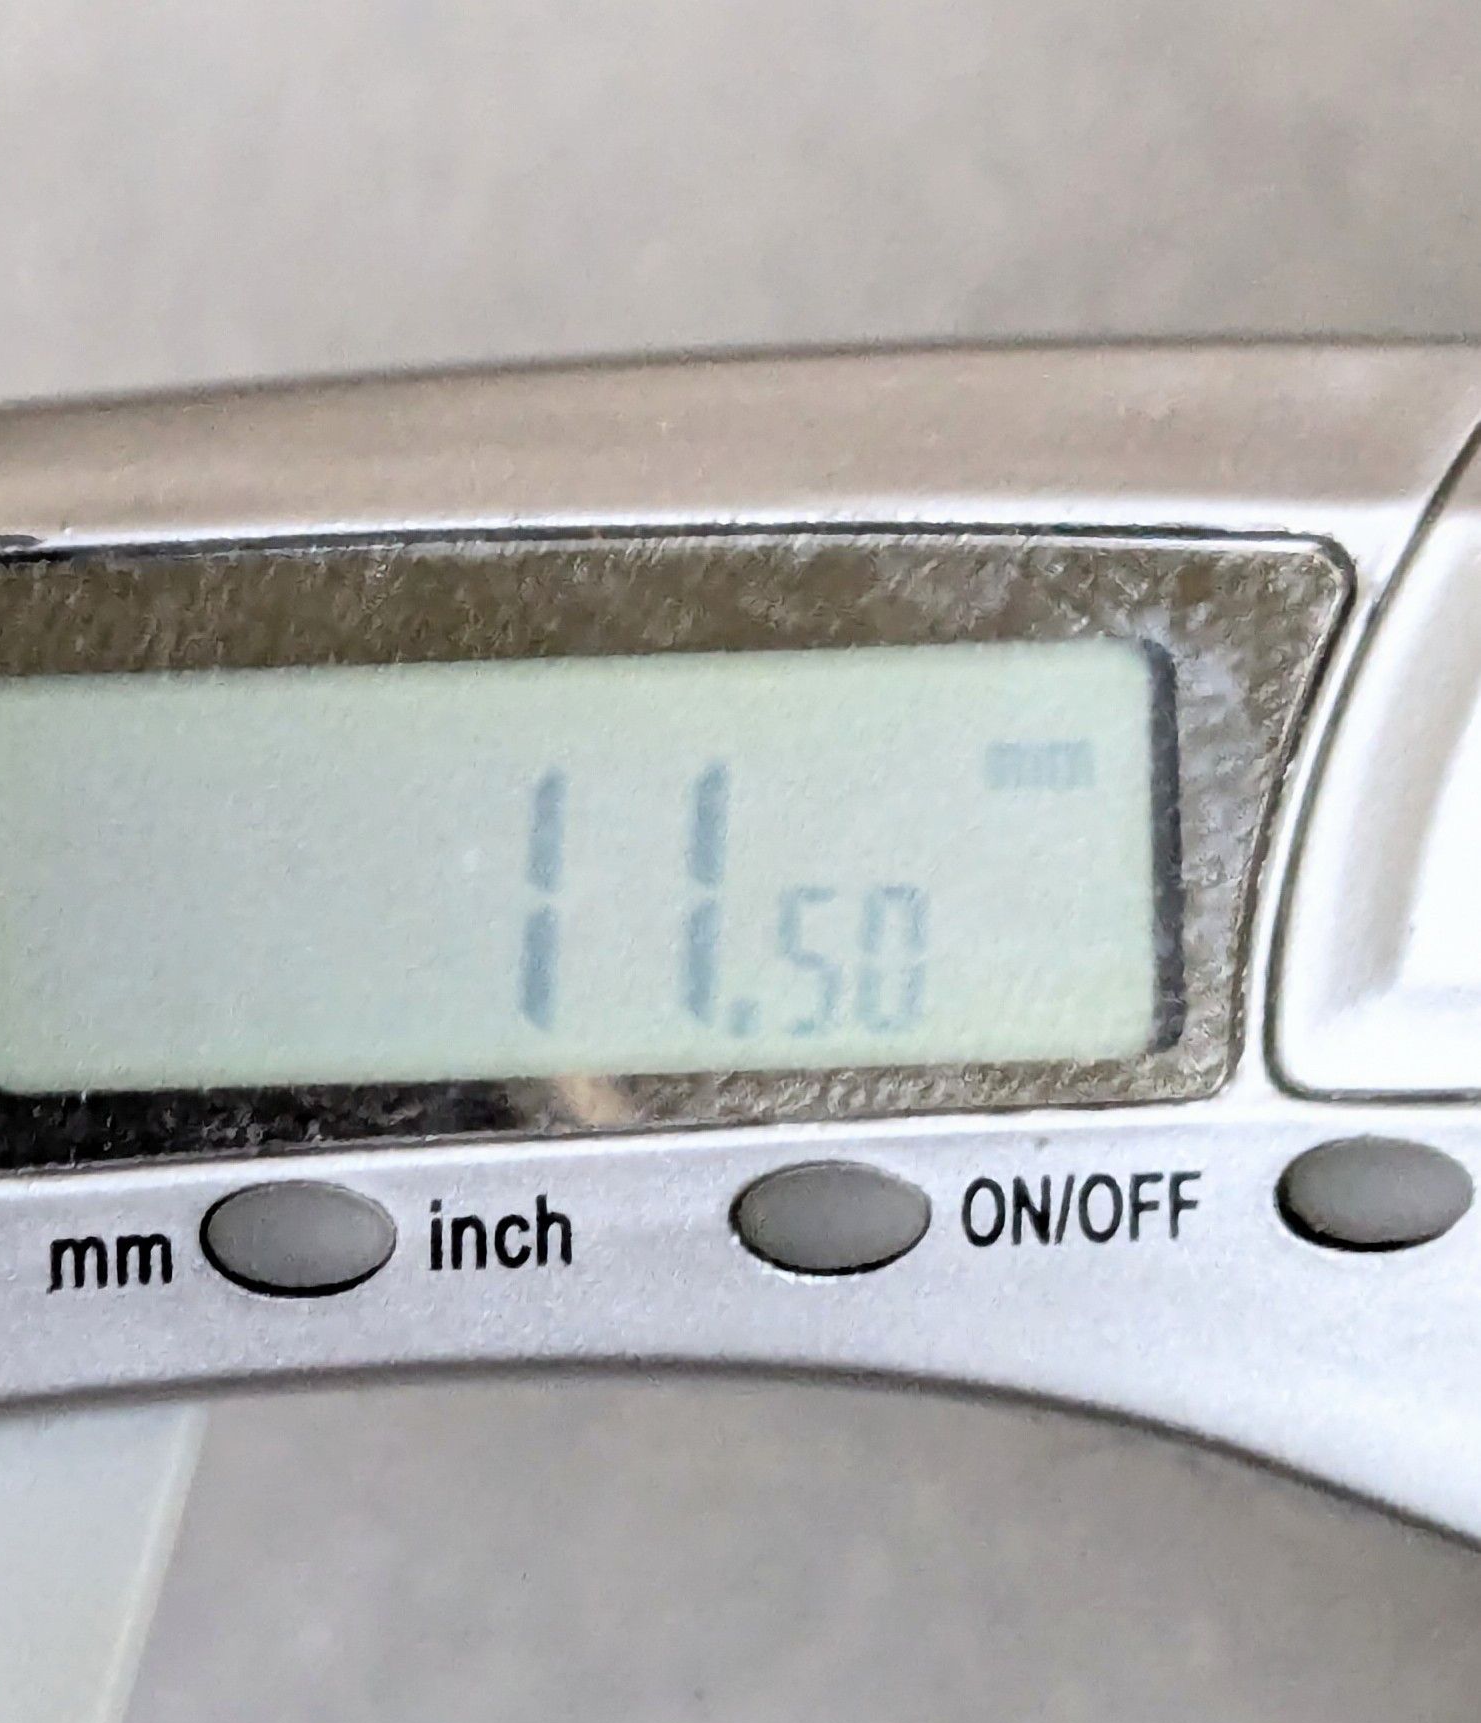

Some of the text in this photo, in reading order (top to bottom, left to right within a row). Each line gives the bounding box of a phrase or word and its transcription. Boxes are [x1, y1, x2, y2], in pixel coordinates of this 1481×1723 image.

[519, 759, 927, 1037] 11.50
[47, 1194, 572, 1293] mm inch
[962, 1171, 1201, 1246] ON/OFF
